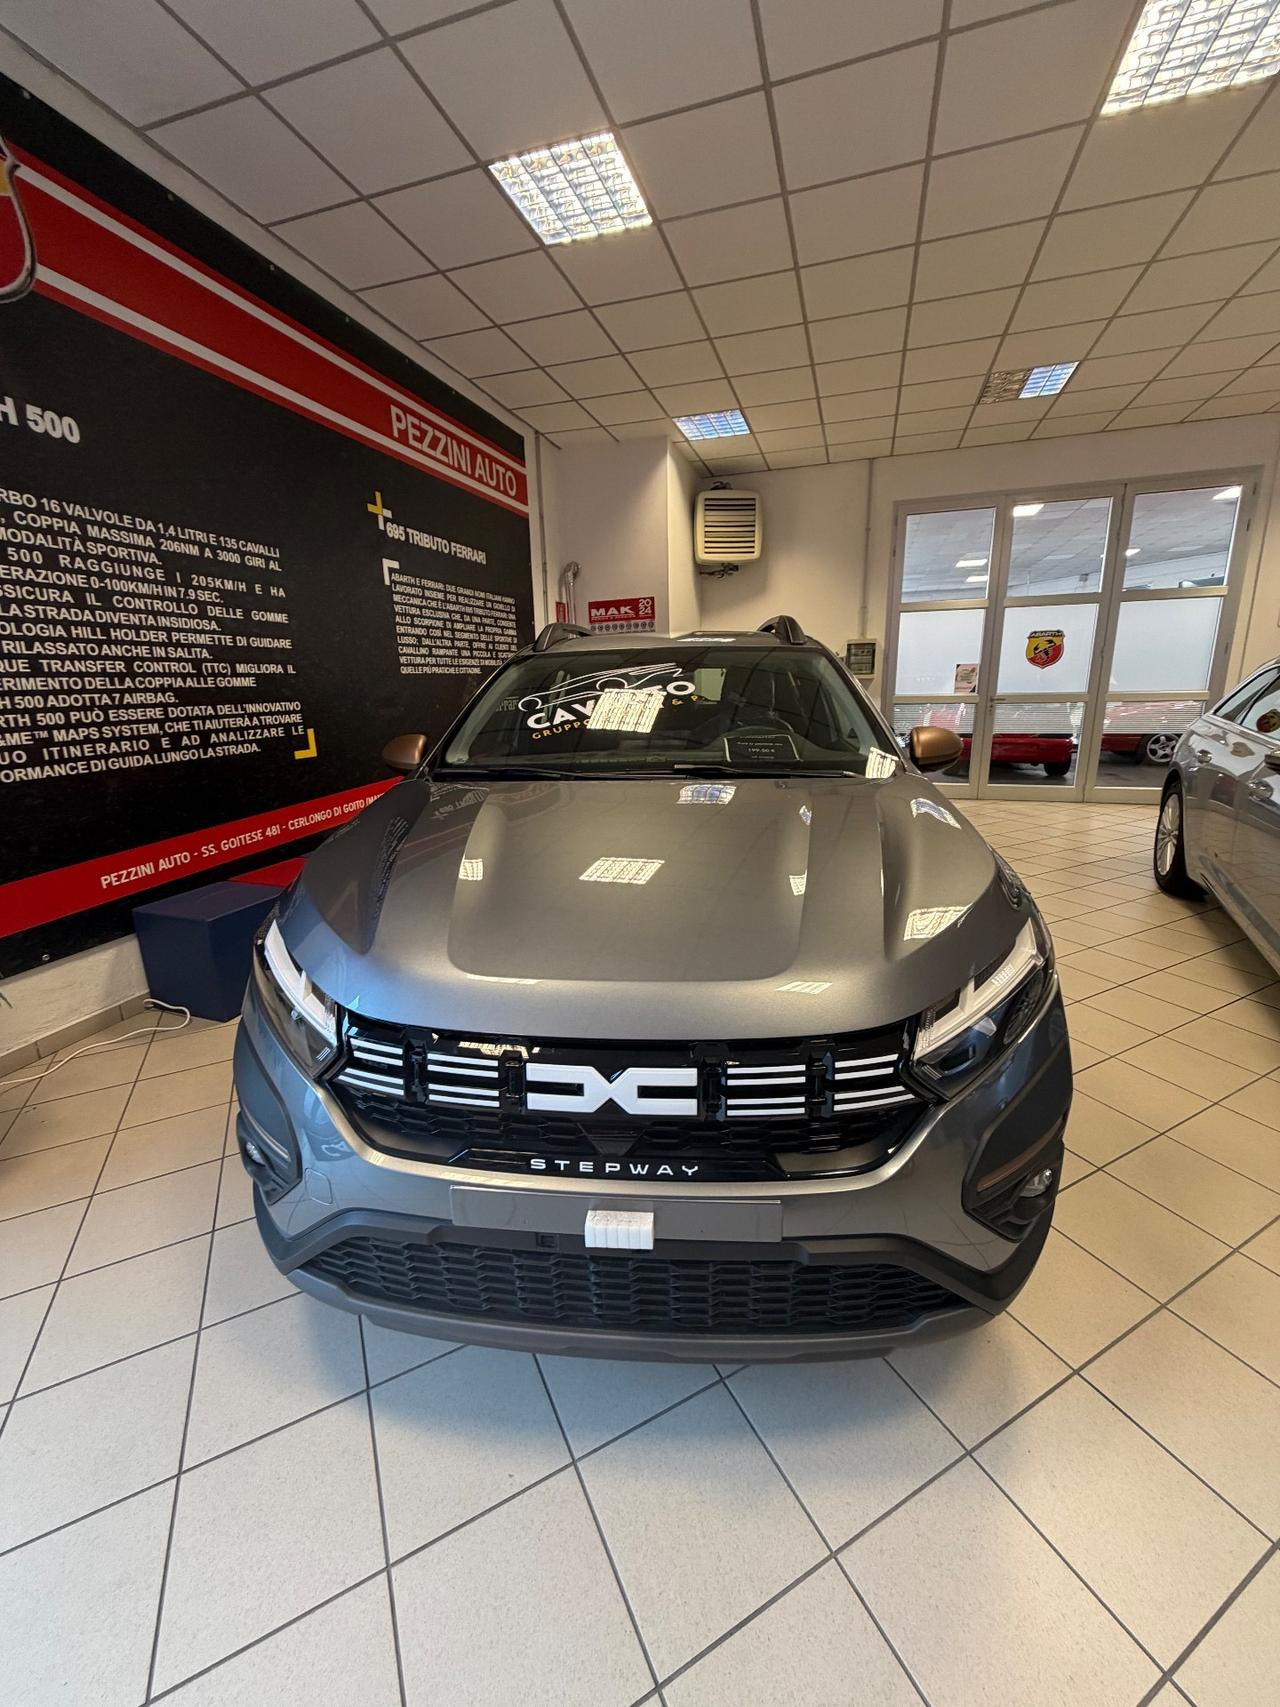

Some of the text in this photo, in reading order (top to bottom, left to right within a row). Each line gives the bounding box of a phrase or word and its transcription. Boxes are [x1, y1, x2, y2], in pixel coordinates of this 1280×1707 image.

[26, 403, 81, 444] 500
[390, 404, 517, 497] PEZZINI AUTO
[41, 498, 61, 513] 16
[62, 501, 134, 528] VALVOLE
[135, 517, 157, 533] DA
[157, 522, 176, 537] 1,4
[177, 527, 208, 543] LITRI
[209, 533, 218, 546] E
[219, 536, 238, 549] 135
[238, 540, 280, 558] CAVALLI
[13, 510, 283, 572] COPPIA MASSIMA 206NM A 3000 GIRI AL
[385, 521, 487, 564] 695 TRIBUTO FERRARI
[86, 541, 163, 565] SPORTIVA.
[7, 547, 286, 598] 500 RAGGIUNGE I 205KM/H E HA
[391, 573, 416, 585] ABARTH
[416, 577, 421, 585] E
[90, 576, 162, 597] 0-100KM/H
[164, 586, 177, 598] IN
[177, 587, 196, 600] 7.9
[196, 590, 224, 603] SEC.
[391, 583, 422, 596] LAVORATO
[85, 592, 102, 606] IL
[112, 595, 198, 615] CONTROLLO
[207, 605, 244, 619] DELLE
[251, 610, 289, 623] GOMME
[393, 594, 427, 607] MECCANICA
[394, 604, 421, 615] VETTURA
[591, 606, 634, 616] MAK
[639, 599, 652, 607] 20
[639, 606, 653, 614] 24
[23, 604, 95, 622] STRADA
[95, 610, 157, 627] DIVENTA
[157, 615, 222, 631] INSIDIOSA.
[395, 615, 411, 624] ALLO
[413, 617, 444, 628] SCORPIONE
[0, 621, 293, 649] OLOGIA HILL HOLDER PERMETTE DI GUIDARE
[396, 625, 427, 636] ENTRANDO
[2, 640, 213, 659] RILASSATO ANCHE IN SALITA.
[398, 646, 429, 656] CAVALLINO
[399, 655, 425, 665] VETTURA
[39, 659, 127, 673] TRANSFER
[133, 661, 197, 673] CONTROL
[202, 662, 231, 675] (TTC)
[235, 663, 284, 674] MIGLIORA
[287, 664, 296, 674] IL
[0, 677, 257, 690] RIMENTO DELLA COPPIA ALLE GOMME
[14, 695, 44, 709] 500
[46, 693, 112, 708] ADOTTA
[112, 693, 121, 705] 7
[123, 692, 179, 705] AIRBAG.
[36, 712, 65, 726] 500
[69, 708, 104, 723] PUÒ
[108, 707, 165, 721] ESSERE
[168, 705, 215, 718] DOTATA
[217, 701, 301, 716] DELL'INNOVATIVO
[52, 727, 100, 742] MAPS
[101, 722, 163, 738] SYSTEM,
[165, 720, 191, 733] CHE
[192, 719, 204, 731] TI
[204, 715, 251, 730] AIUTERÀ
[251, 716, 260, 727] A
[260, 714, 303, 726] TROVARE
[42, 739, 150, 760] ITINERARIO
[161, 737, 171, 748] E
[181, 735, 200, 747] AD
[210, 727, 285, 744] ANALIZZARE
[292, 725, 305, 735] LE
[0, 743, 261, 783] ORMANCE DI GUIDA LUNGO LA STRADA.
[100, 800, 365, 889] PEZZINI AUTO SS. GOITESE 481 CERLONGO DI GOITO
[530, 1158, 698, 1176] STEPWAY
